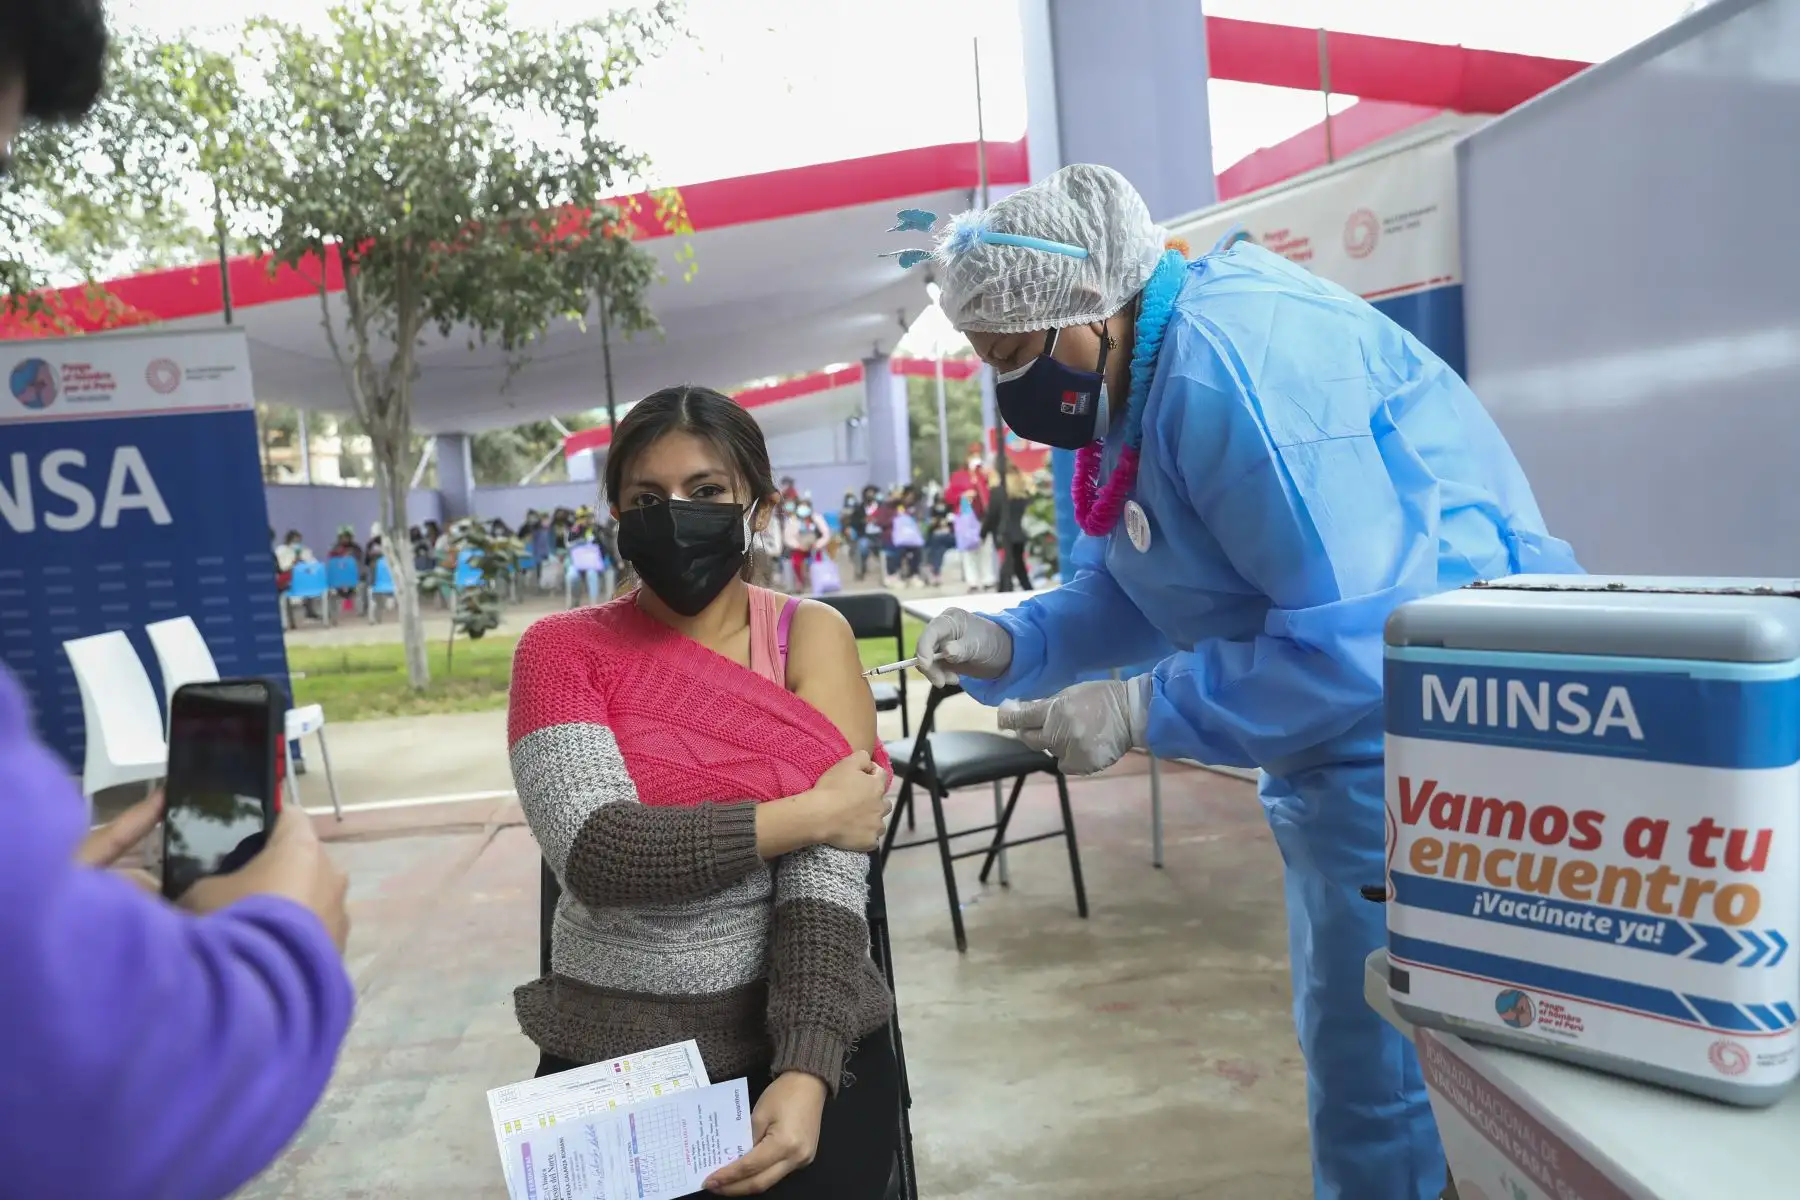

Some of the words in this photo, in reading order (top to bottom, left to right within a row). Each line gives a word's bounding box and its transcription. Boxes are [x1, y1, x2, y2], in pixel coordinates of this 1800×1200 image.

[1421, 674, 1645, 740] MINSA
[1398, 776, 1606, 851] Vamos
[1623, 816, 1669, 860] a
[1687, 817, 1774, 872] tu
[1408, 837, 1761, 926] encuentro
[1472, 892, 1612, 935] ¡Vacúnate
[1615, 918, 1666, 945] ya!
[1476, 1082, 1538, 1151] NACIONAL
[1540, 1138, 1561, 1170] DE
